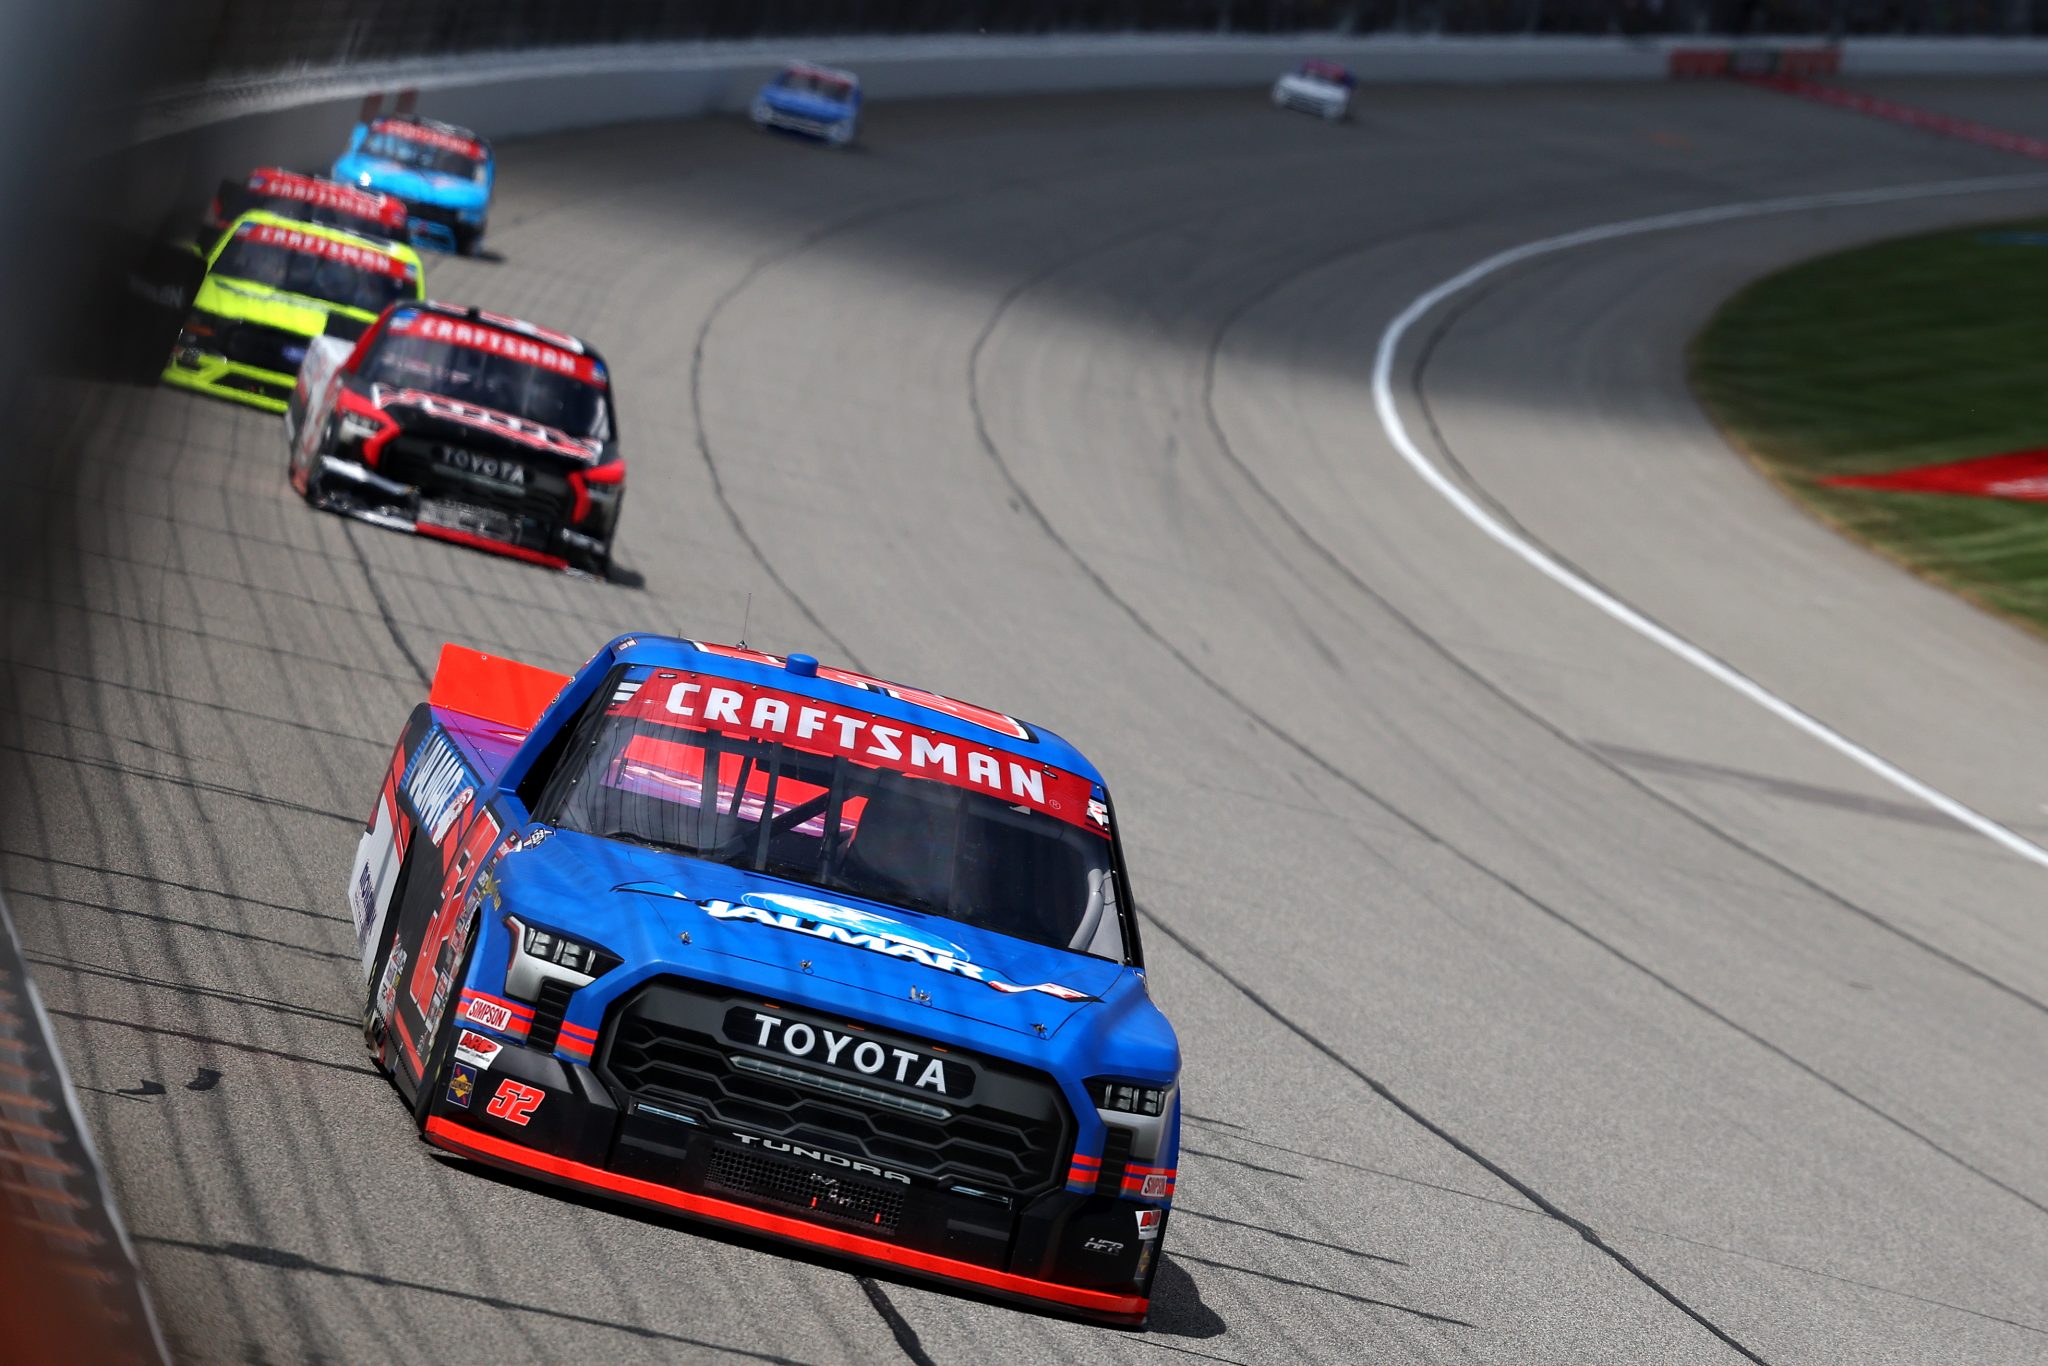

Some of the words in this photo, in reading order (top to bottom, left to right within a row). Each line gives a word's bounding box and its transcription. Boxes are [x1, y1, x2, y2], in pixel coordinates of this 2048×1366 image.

[260, 228, 390, 273] CRAFTSMAN
[419, 318, 577, 373] CRAFTSMAN
[442, 448, 525, 485] TOYOTA
[665, 682, 1045, 805] CRAFTSMAN
[468, 1000, 507, 1029] SIMPSON
[459, 1031, 498, 1054] ARP
[754, 1013, 948, 1095] TOYOTA
[486, 1078, 546, 1126] 52
[732, 1132, 912, 1185] TUNDRA
